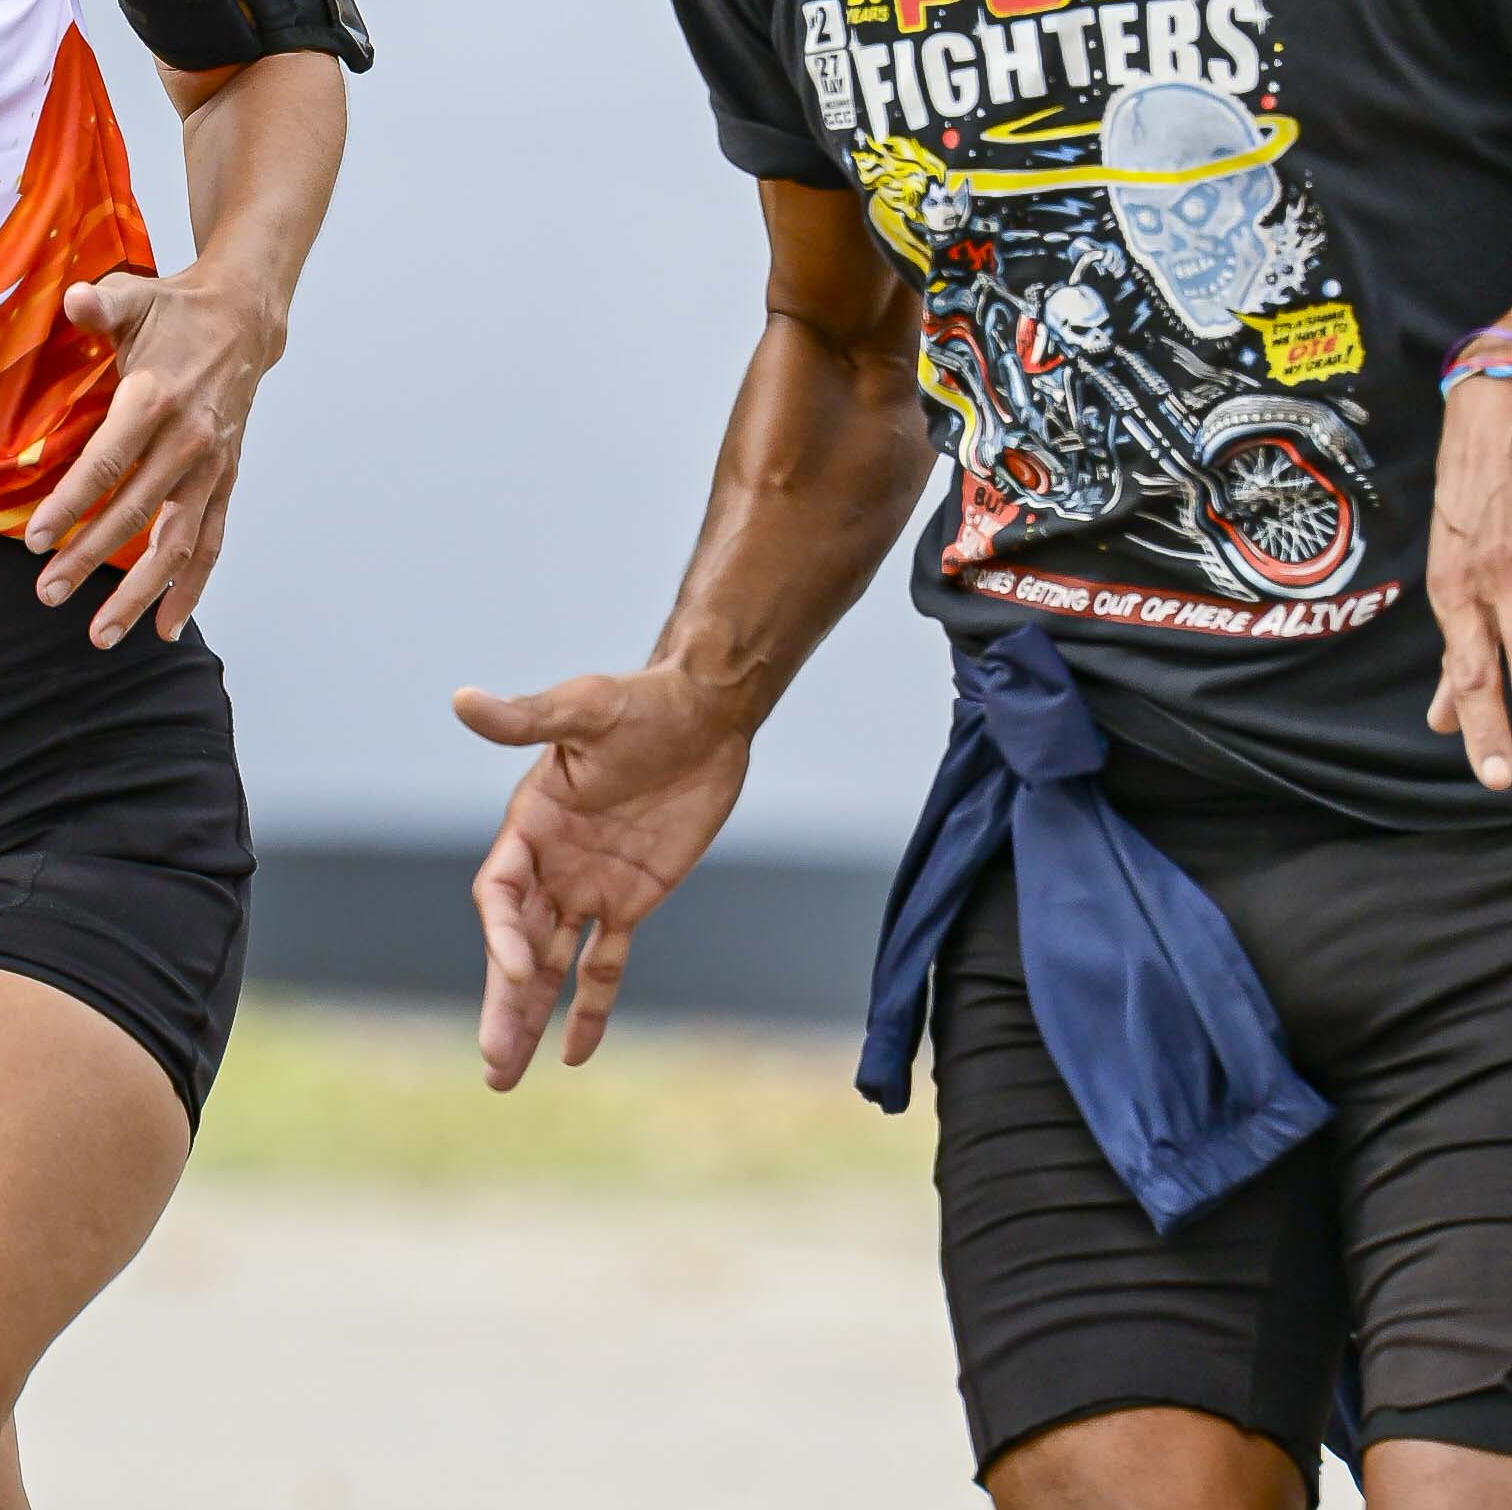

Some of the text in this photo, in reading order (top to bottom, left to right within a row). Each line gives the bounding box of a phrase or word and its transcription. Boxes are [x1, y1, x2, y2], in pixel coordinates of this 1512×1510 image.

[1015, 574, 1091, 612] GETTING
[1093, 590, 1143, 617] OUT
[1139, 596, 1180, 622] OF
[1174, 602, 1253, 633] HERE
[1250, 586, 1401, 638] ALIVE!
